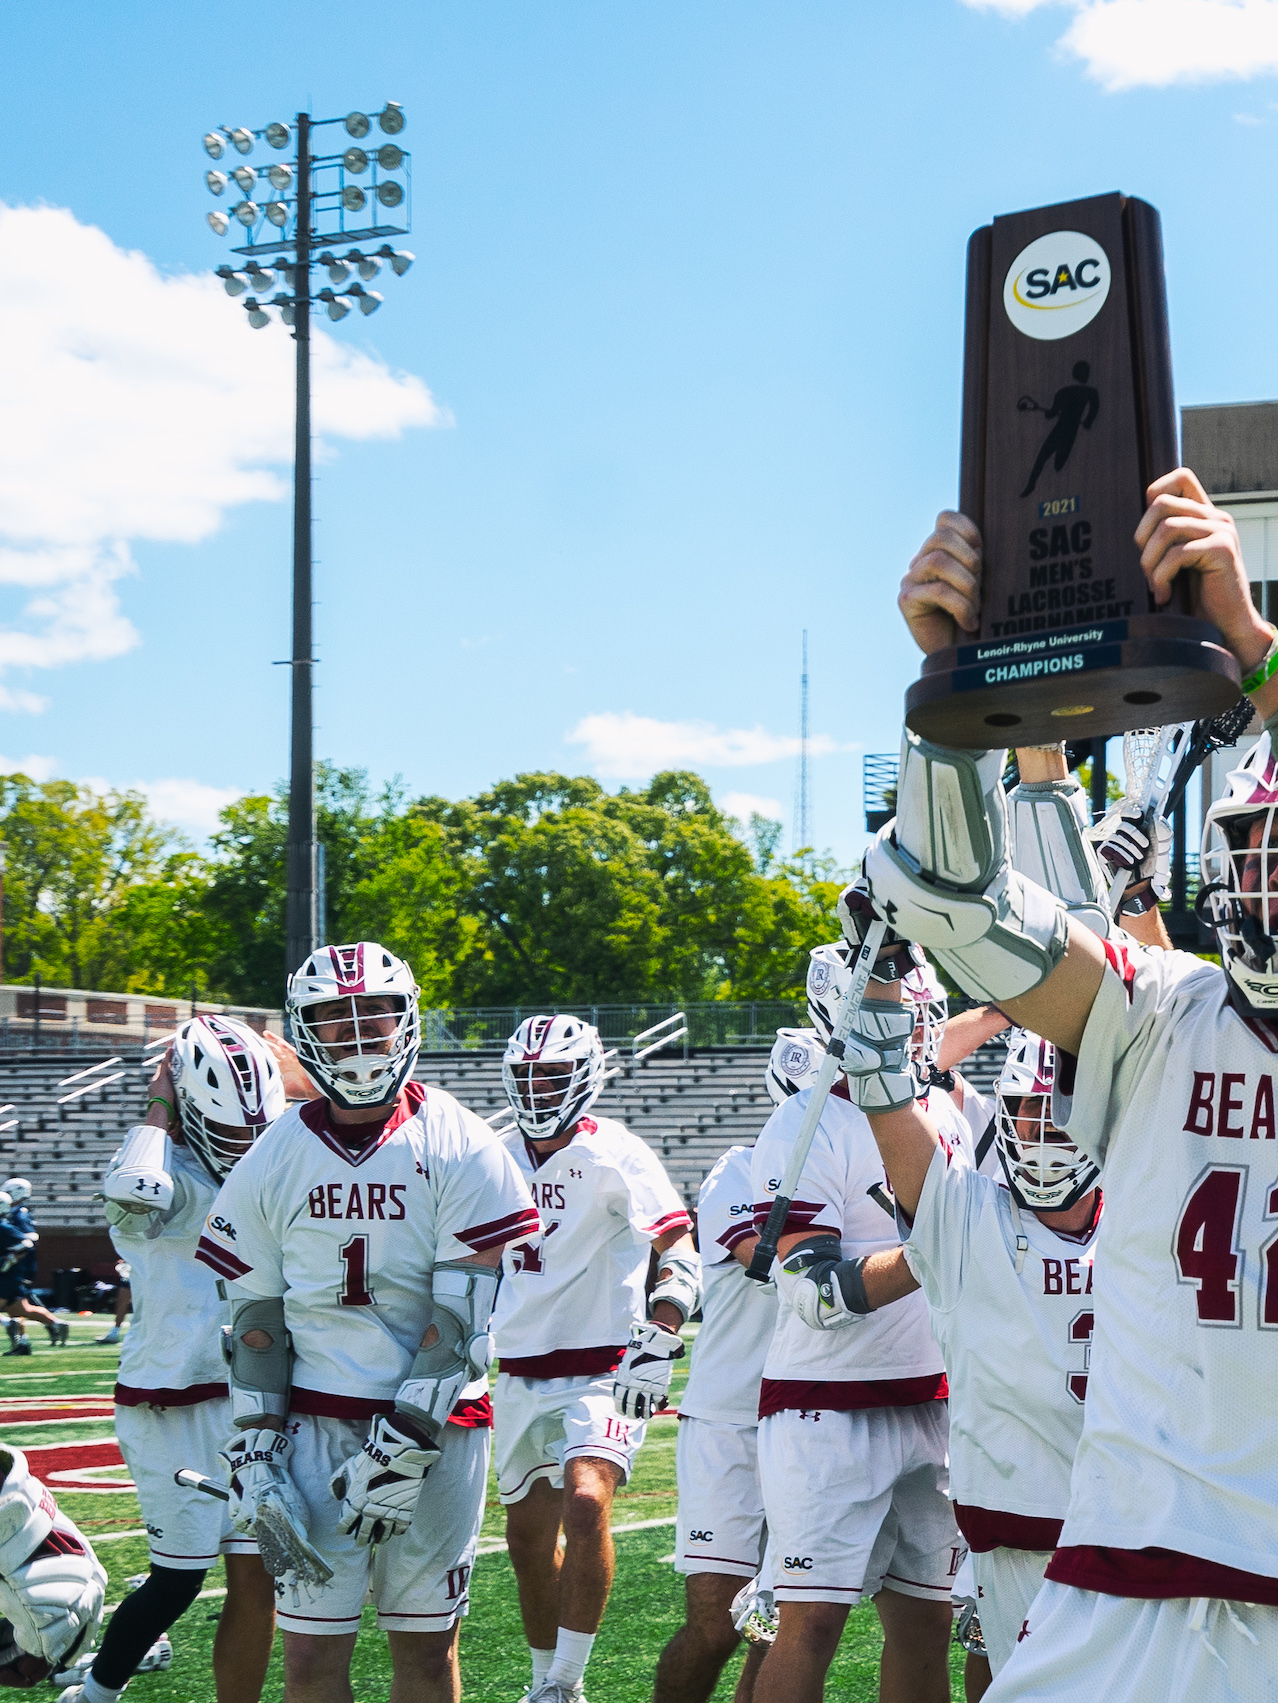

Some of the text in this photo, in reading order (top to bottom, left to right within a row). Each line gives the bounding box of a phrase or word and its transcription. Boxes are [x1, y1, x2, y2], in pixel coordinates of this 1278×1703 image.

[1026, 258, 1101, 299] SAC
[1042, 497, 1076, 517] 2021
[1028, 520, 1093, 561] SAC
[1029, 557, 1093, 588] MEN'S
[1007, 578, 1116, 617] LACROSSE
[990, 601, 1134, 638] TOURNAMENT
[977, 629, 1104, 659] Lenoir-Rhyne University
[984, 654, 1084, 683] CHAMPIONS
[308, 1183, 407, 1220] BEARS
[336, 1233, 378, 1306] 1
[603, 1416, 630, 1446] LR
[229, 1451, 273, 1473] BEARS
[689, 1530, 714, 1542] SAC
[784, 1556, 813, 1570] SAC
